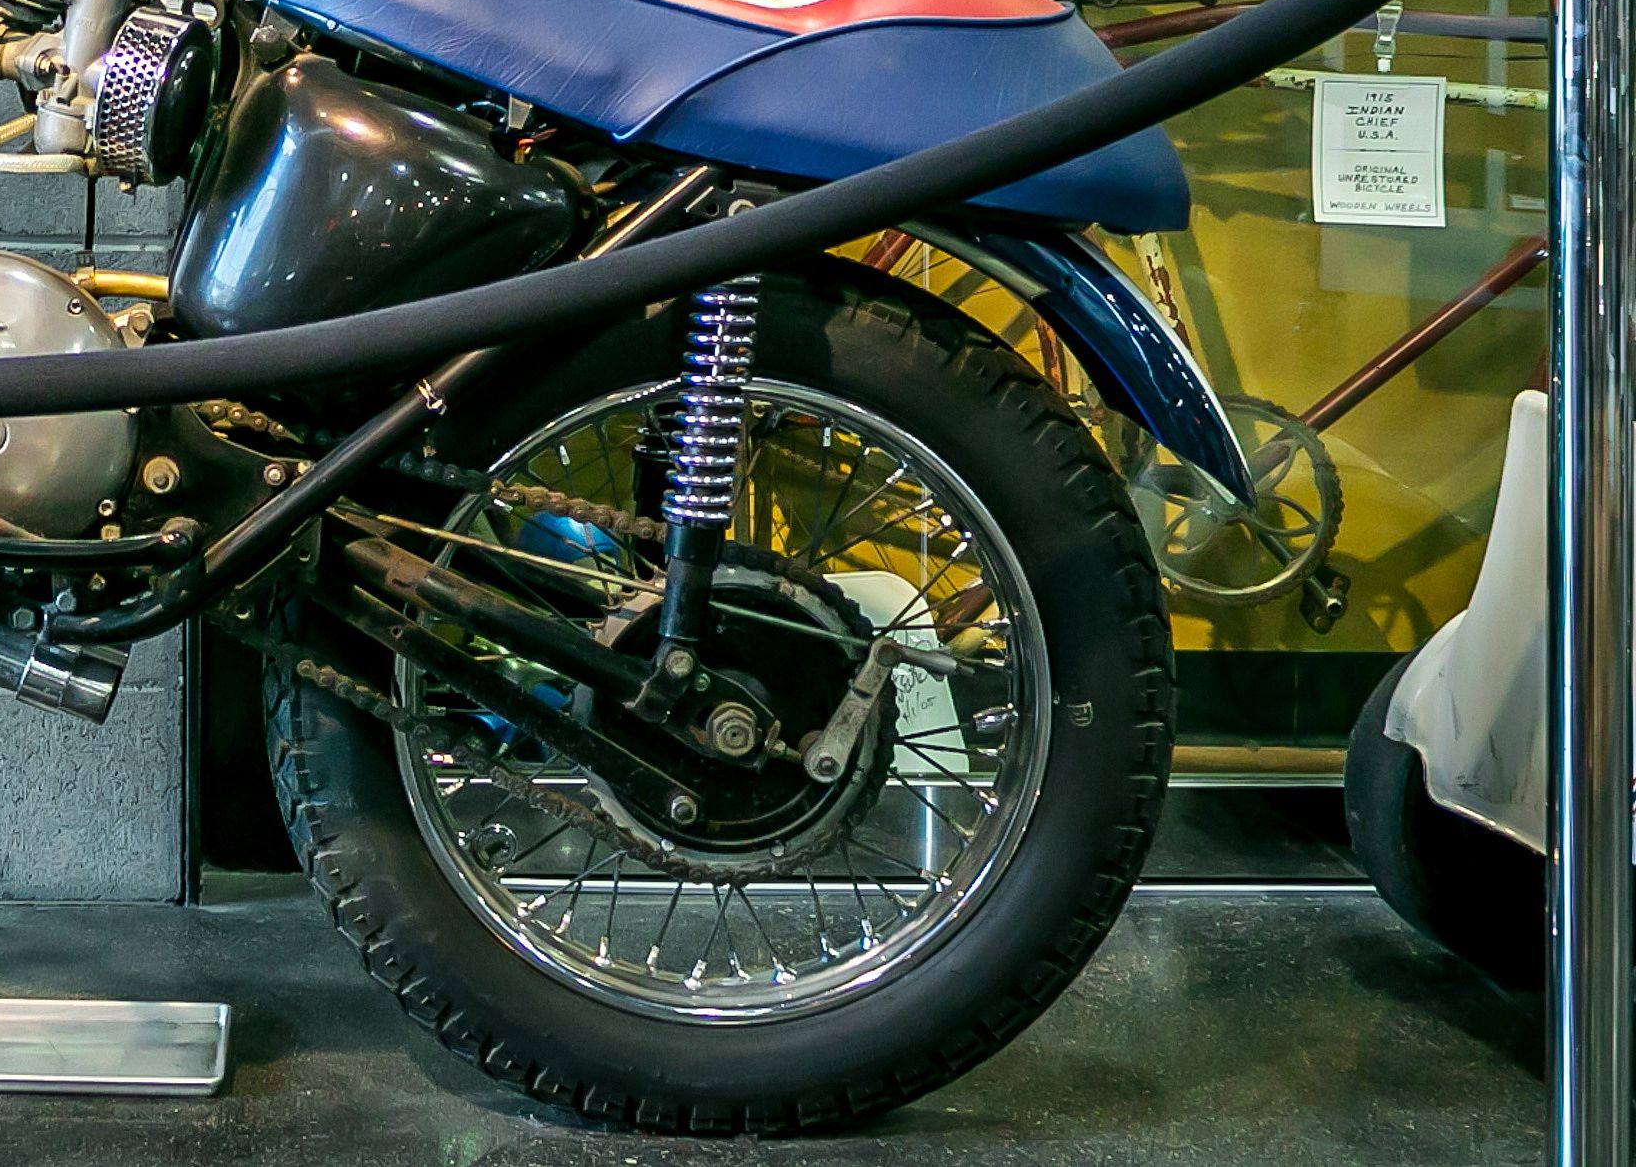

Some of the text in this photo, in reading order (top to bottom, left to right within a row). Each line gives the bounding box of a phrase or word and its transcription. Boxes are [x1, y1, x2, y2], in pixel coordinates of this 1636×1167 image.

[1365, 92, 1395, 103] 1915
[1345, 106, 1405, 115] INDIAN
[1355, 116, 1399, 127] CHIEF
[1357, 130, 1399, 140] U.S.A.
[1354, 165, 1407, 175] ORIGINAL
[1337, 173, 1419, 184] UNRESTORED
[1355, 184, 1405, 194] BICYCLE
[1329, 200, 1432, 212] WOODEN WHEELS
